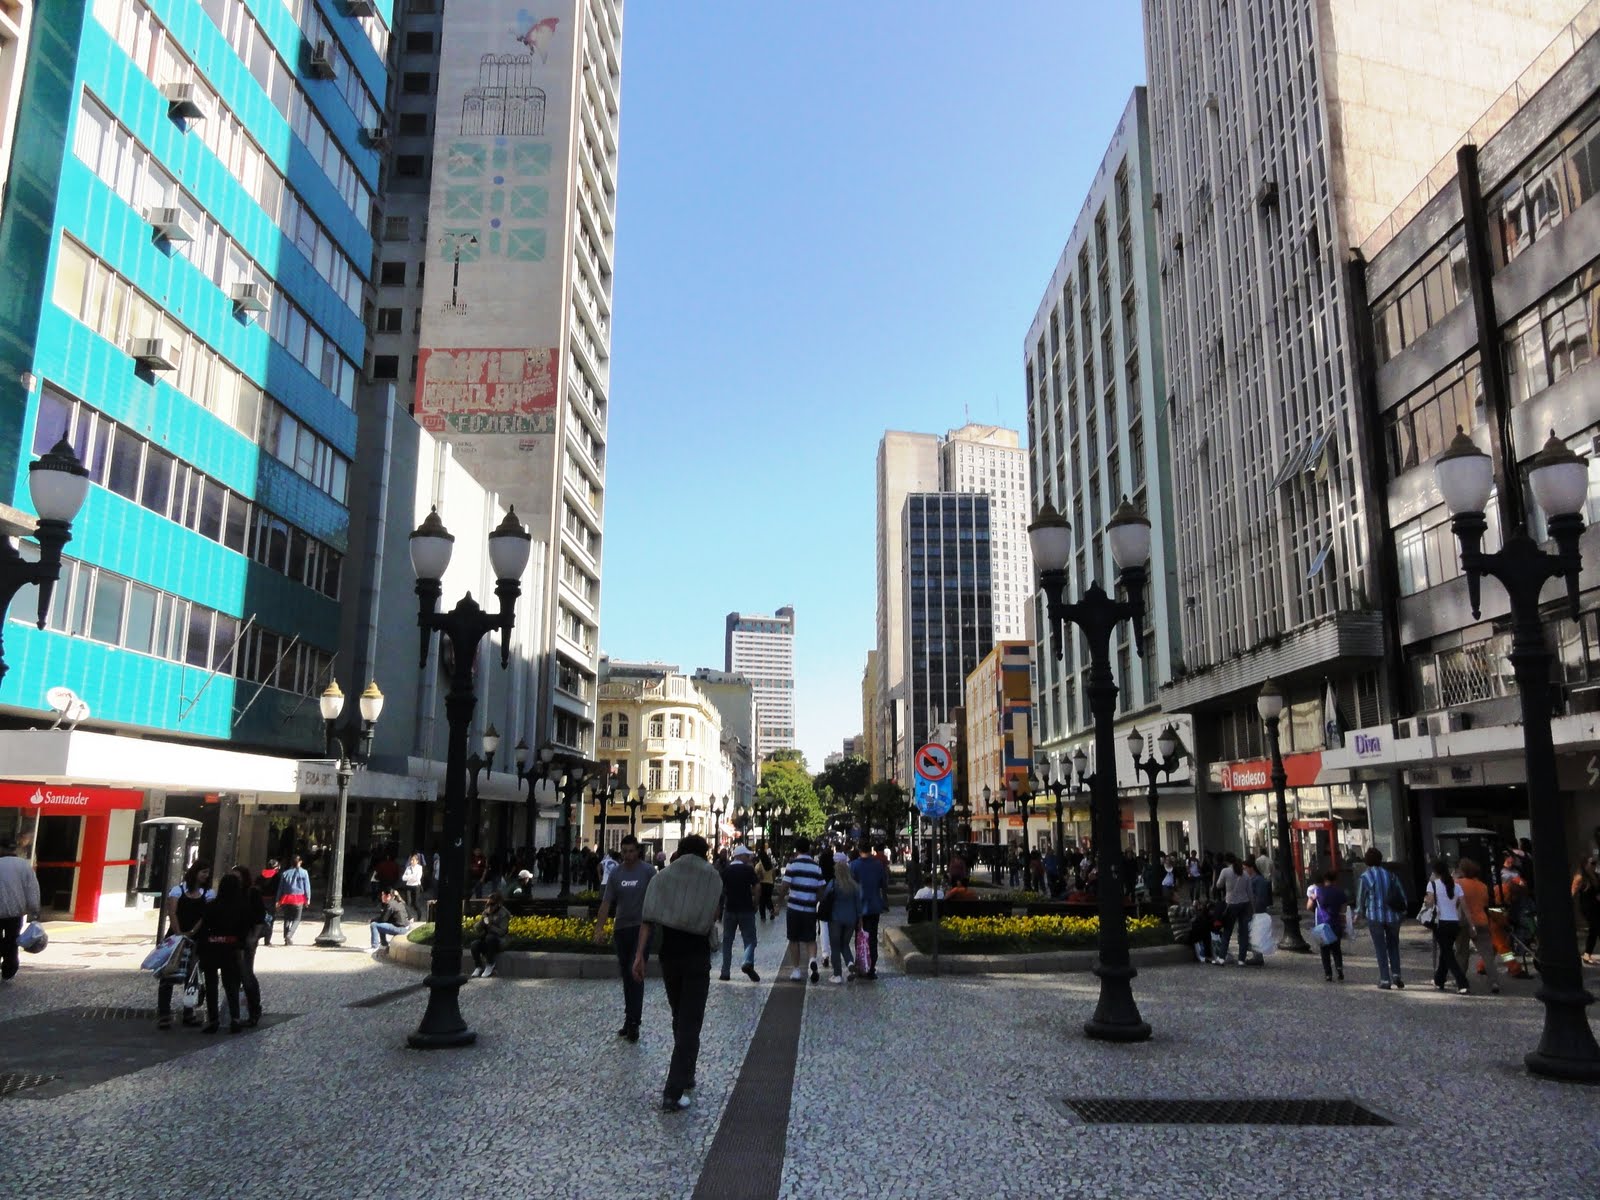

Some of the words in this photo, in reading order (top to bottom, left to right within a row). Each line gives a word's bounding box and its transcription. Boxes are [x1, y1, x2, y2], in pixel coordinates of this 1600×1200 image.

[456, 414, 548, 433] FUJIFILM
[1354, 734, 1381, 754] Diva
[1232, 769, 1266, 787] Bradesco
[44, 790, 90, 806] Santander
